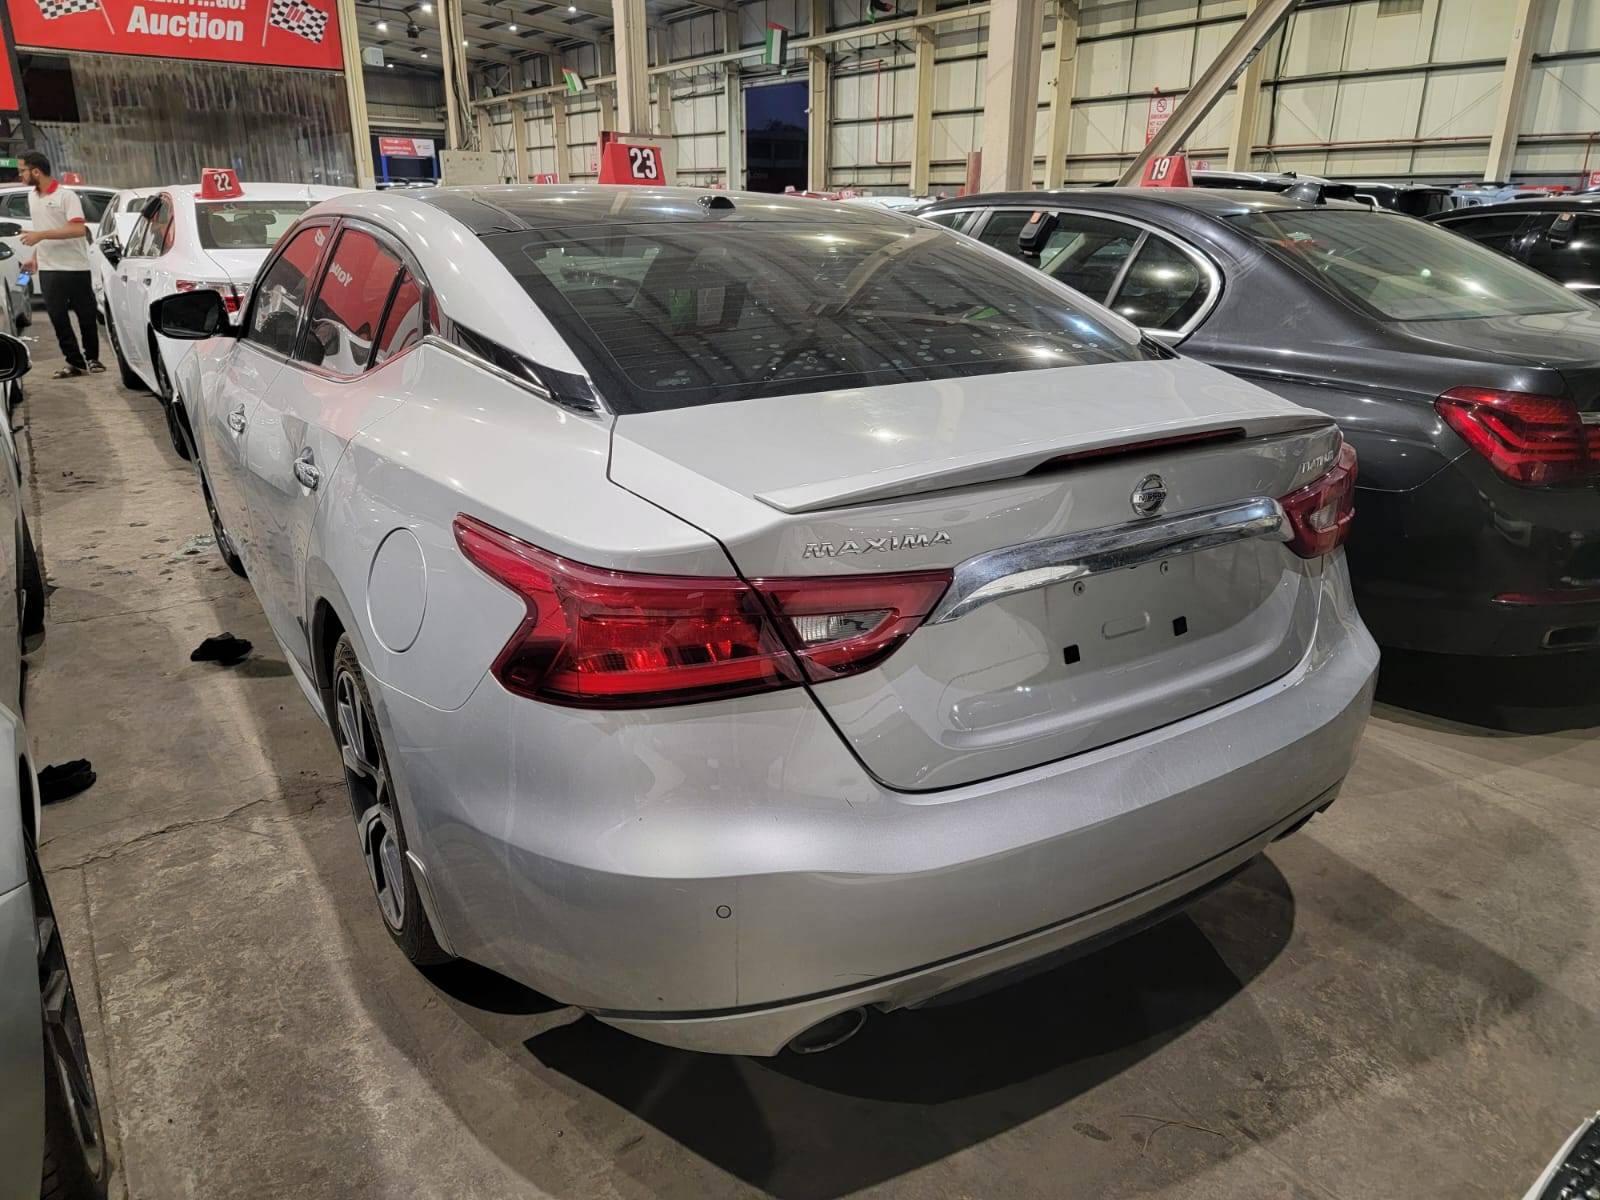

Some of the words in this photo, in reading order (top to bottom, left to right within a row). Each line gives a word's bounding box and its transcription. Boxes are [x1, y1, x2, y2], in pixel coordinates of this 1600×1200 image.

[126, 5, 244, 41] Auction
[630, 147, 657, 178] 23
[1151, 158, 1171, 180] 19
[213, 172, 233, 192] 22
[803, 530, 952, 558] MAXIMA
